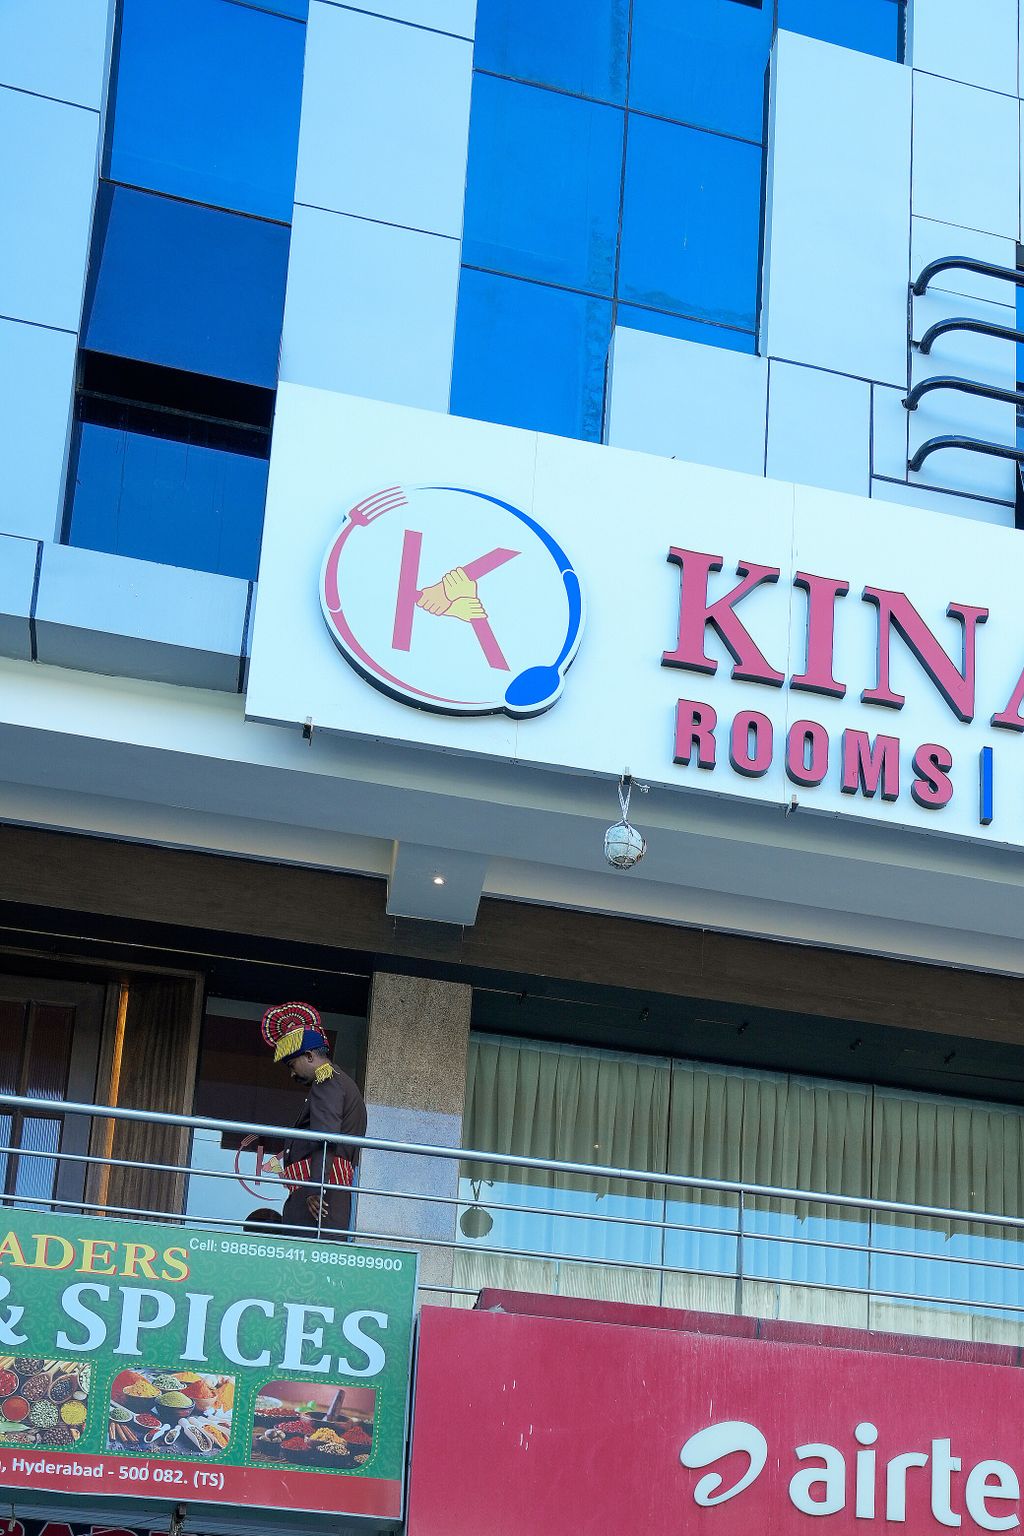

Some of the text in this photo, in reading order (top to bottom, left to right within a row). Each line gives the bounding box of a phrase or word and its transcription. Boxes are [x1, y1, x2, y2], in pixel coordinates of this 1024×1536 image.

[673, 698, 954, 809] ROOMS
[189, 1237, 217, 1252] Cell:
[311, 1252, 402, 1271] 9885899900
[56, 1282, 389, 1378] SPICES
[12, 1457, 104, 1478] Hyderabad
[119, 1465, 150, 1480] 500
[153, 1468, 188, 1484] 082.
[193, 1470, 225, 1489] (TS)
